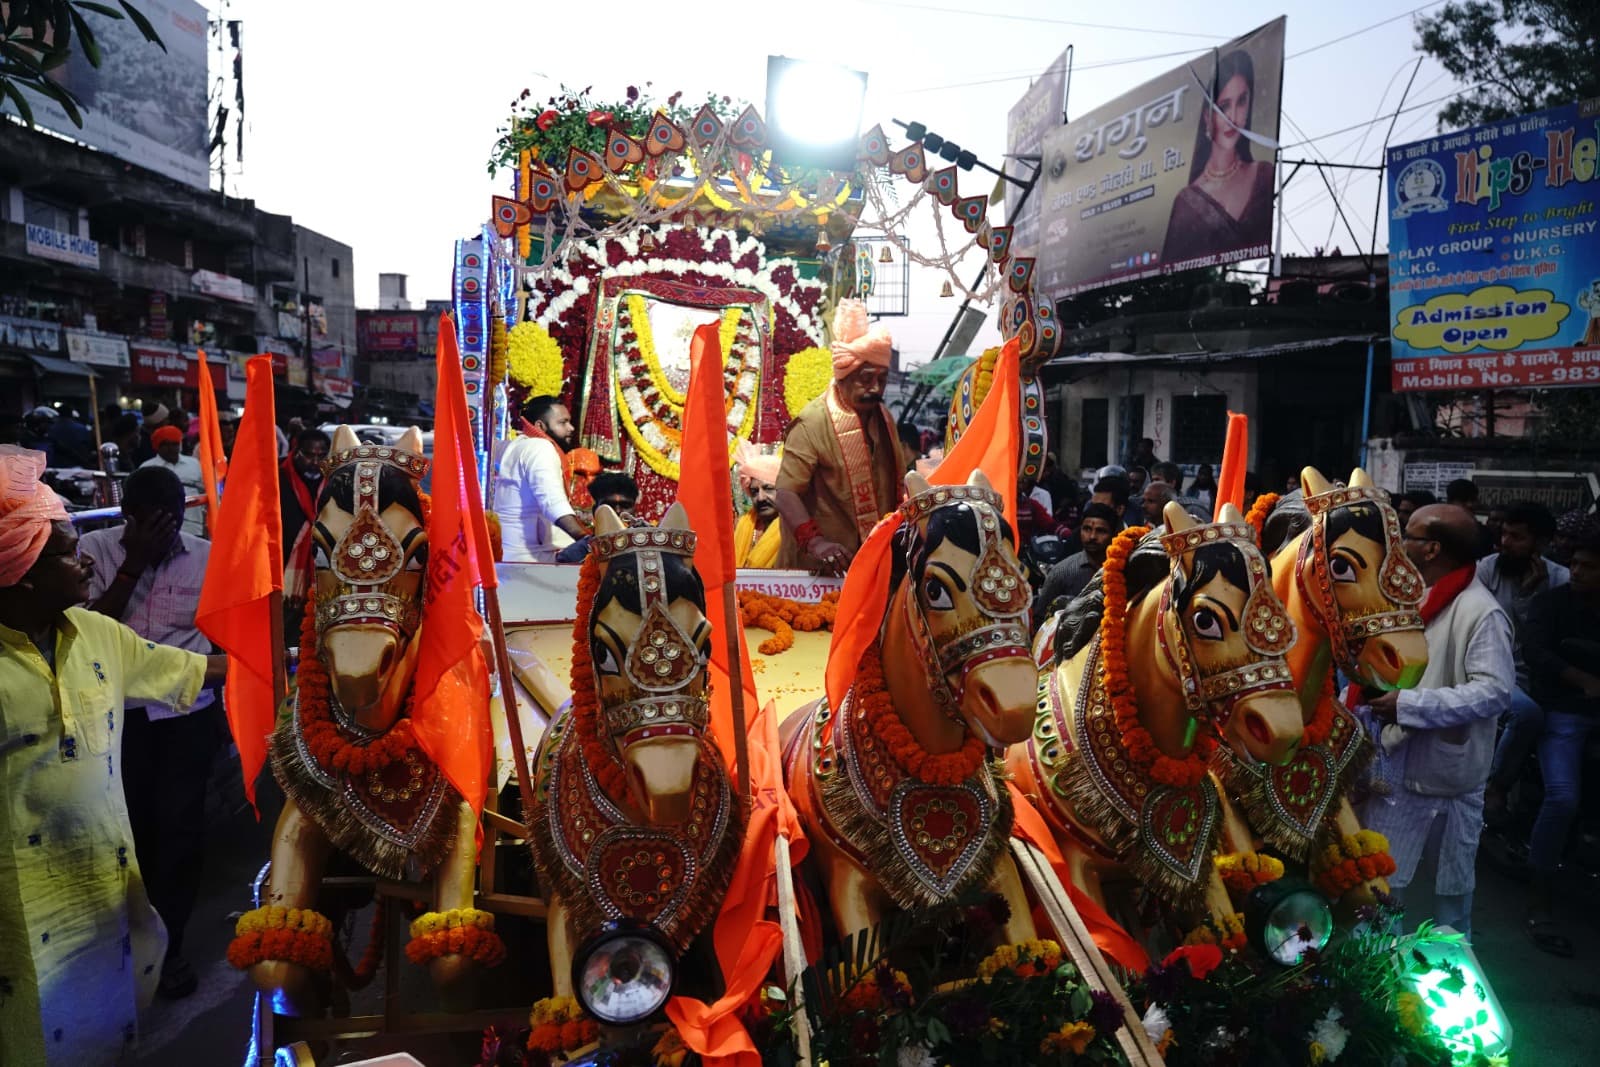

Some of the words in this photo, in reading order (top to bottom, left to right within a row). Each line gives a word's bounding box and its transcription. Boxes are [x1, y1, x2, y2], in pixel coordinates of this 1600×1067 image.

[1392, 151, 1403, 163] 15
[1448, 221, 1481, 235] First
[1485, 213, 1518, 231] Step
[1523, 208, 1538, 222] to
[1544, 201, 1595, 223] Bright
[28, 225, 67, 250] MOBILE
[70, 238, 97, 257] HOME
[1513, 220, 1598, 245] NURSERY
[1399, 245, 1435, 260] PLAY
[1439, 236, 1494, 255] GROUP
[1513, 243, 1566, 261] U.K.G.
[1398, 262, 1441, 276] L.K.G.
[1411, 300, 1548, 326] Admission
[1442, 326, 1508, 346] Open
[1395, 361, 1414, 373] पता
[1429, 356, 1463, 371] मिशन
[1467, 355, 1498, 372] स्कूल
[1503, 353, 1517, 367] के
[1402, 371, 1474, 388] Mobile
